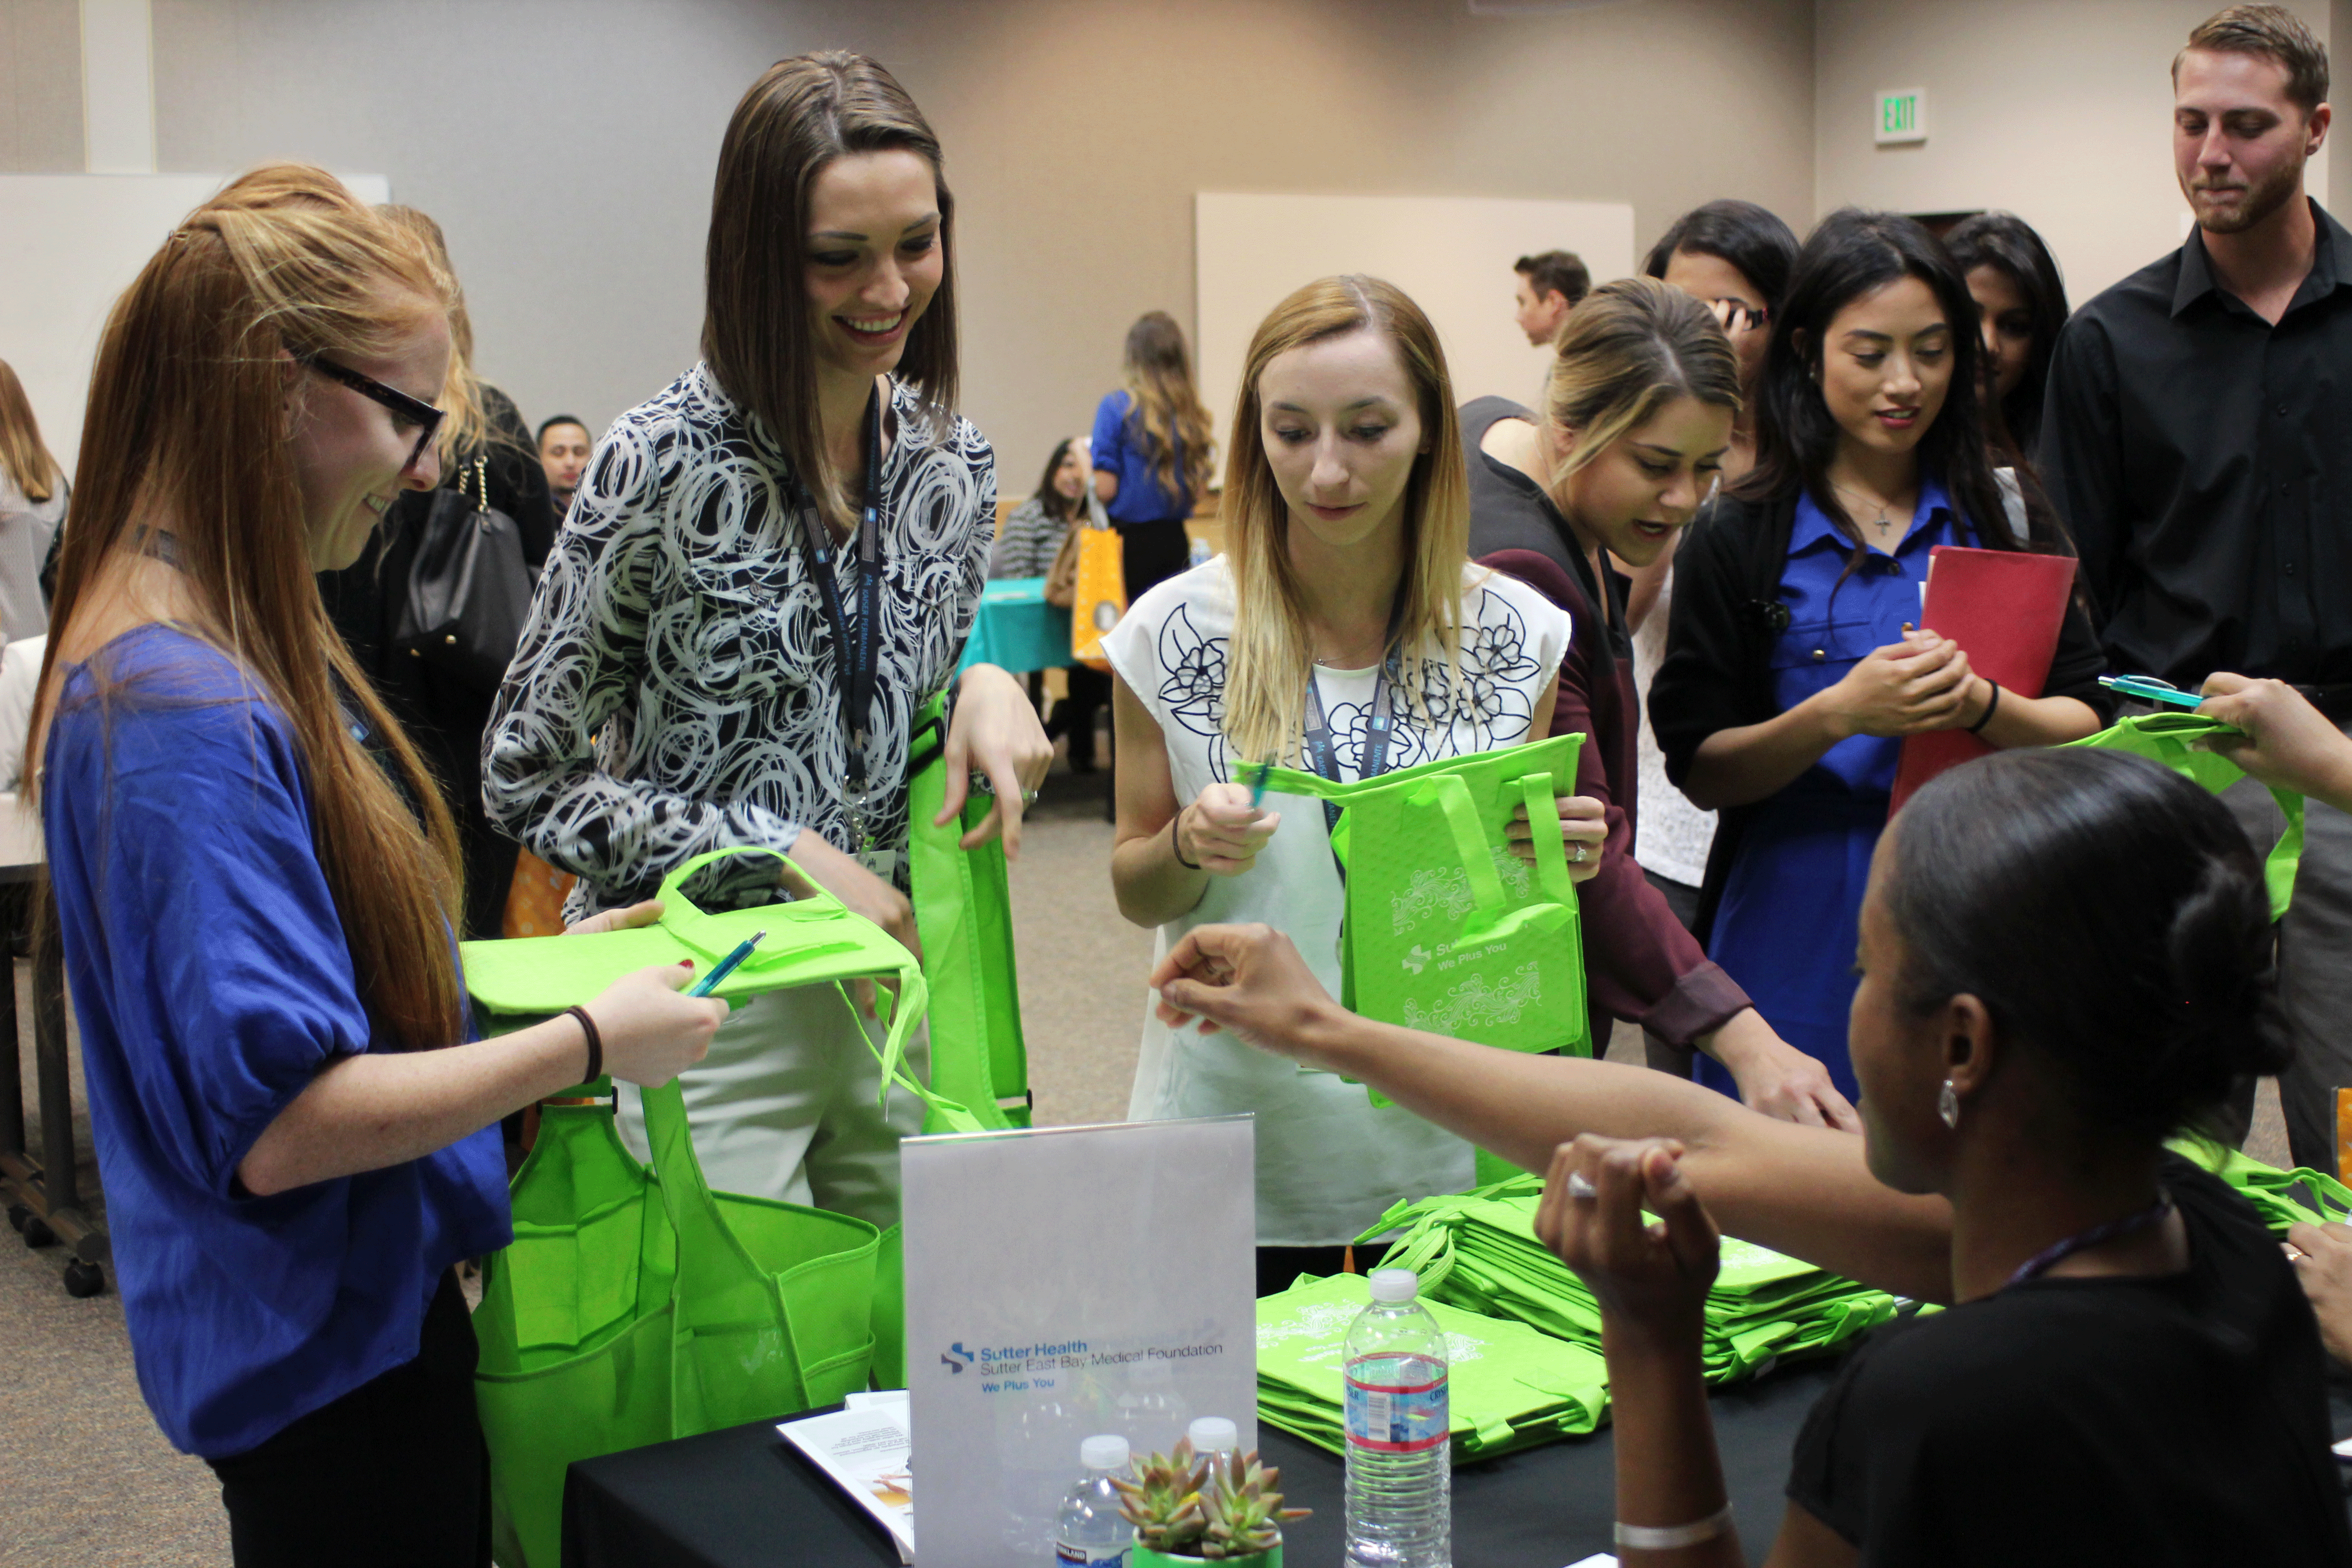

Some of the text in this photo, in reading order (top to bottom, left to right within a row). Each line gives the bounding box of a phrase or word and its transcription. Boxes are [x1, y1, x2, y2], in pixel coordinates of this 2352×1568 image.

[1884, 96, 1916, 132] EXIT
[859, 617, 869, 671] PERMANENTE
[1437, 943, 1506, 971] We Plus You
[981, 1340, 1087, 1361] Sutter Health
[981, 1344, 1223, 1376] Sutter East Bay Medical Foundation
[982, 1377, 1054, 1392] We Plus You
